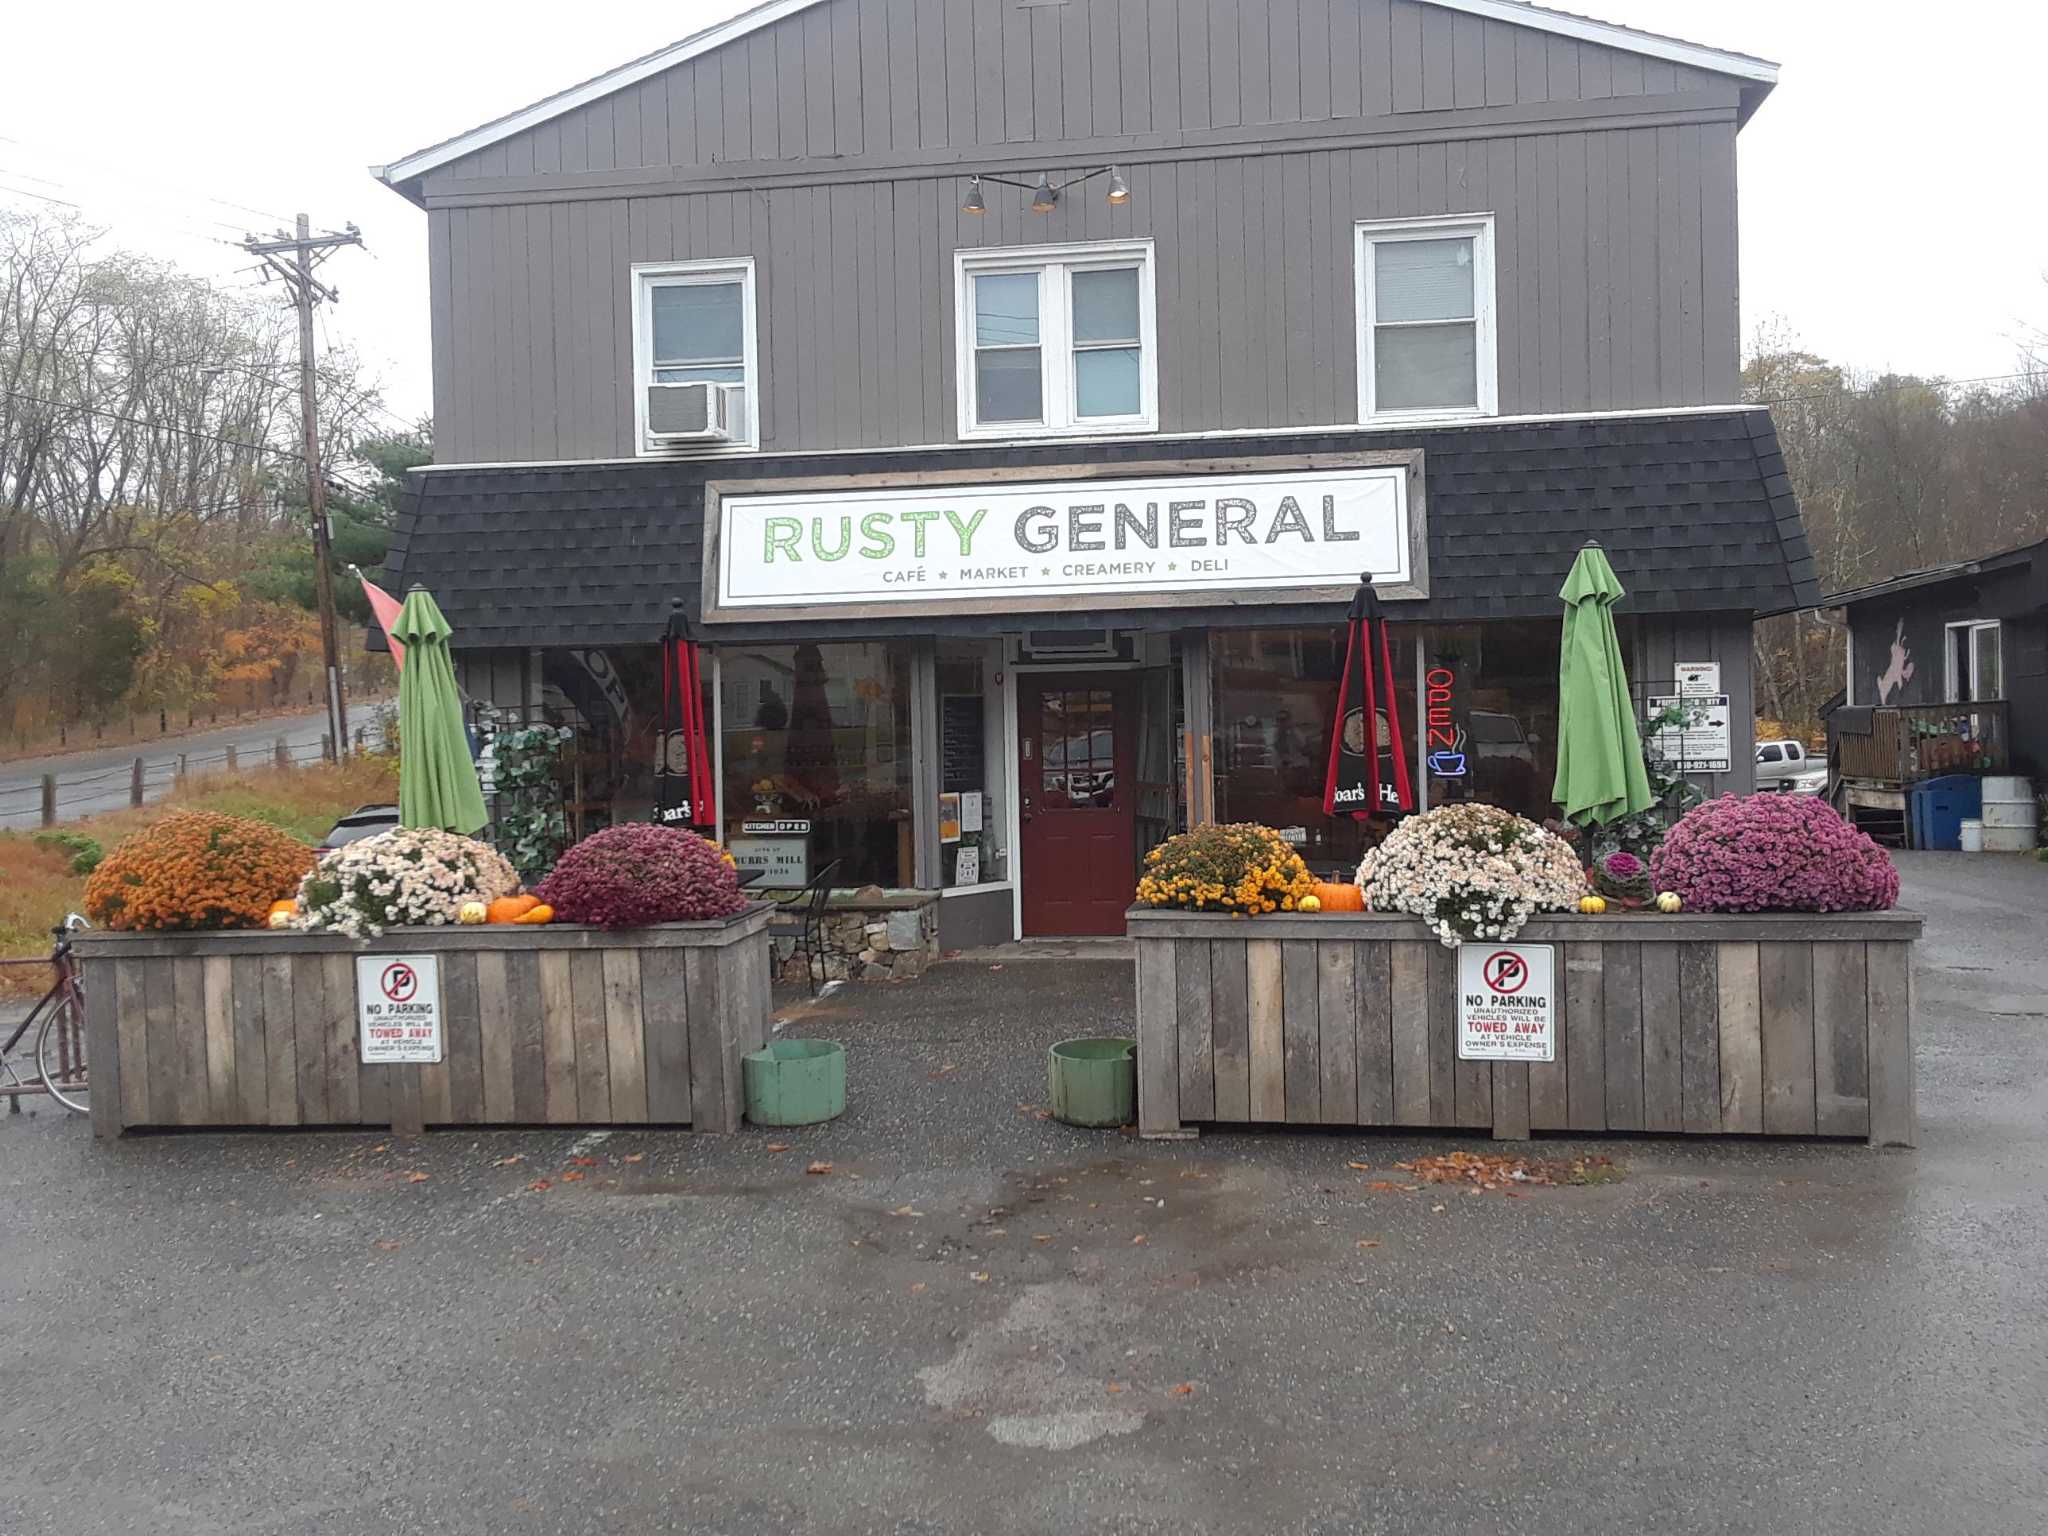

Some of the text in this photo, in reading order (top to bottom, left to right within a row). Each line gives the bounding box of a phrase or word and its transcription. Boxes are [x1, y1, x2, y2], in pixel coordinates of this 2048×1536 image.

[764, 495, 1360, 563] RUSTY GENERAL
[882, 559, 1228, 583] CAFÉ MARKET CREAMERY DELI
[1426, 668, 1455, 748] OPEN
[1333, 782, 1400, 803] oar's He
[776, 855, 803, 865] MILL
[1466, 995, 1547, 1008] NO PARKING
[366, 1003, 433, 1014] NO PARKING
[369, 1028, 433, 1038] TOWED AWAY
[1467, 1022, 1545, 1034] TOWED AWAY
[1507, 1041, 1547, 1049] EXPENSE
